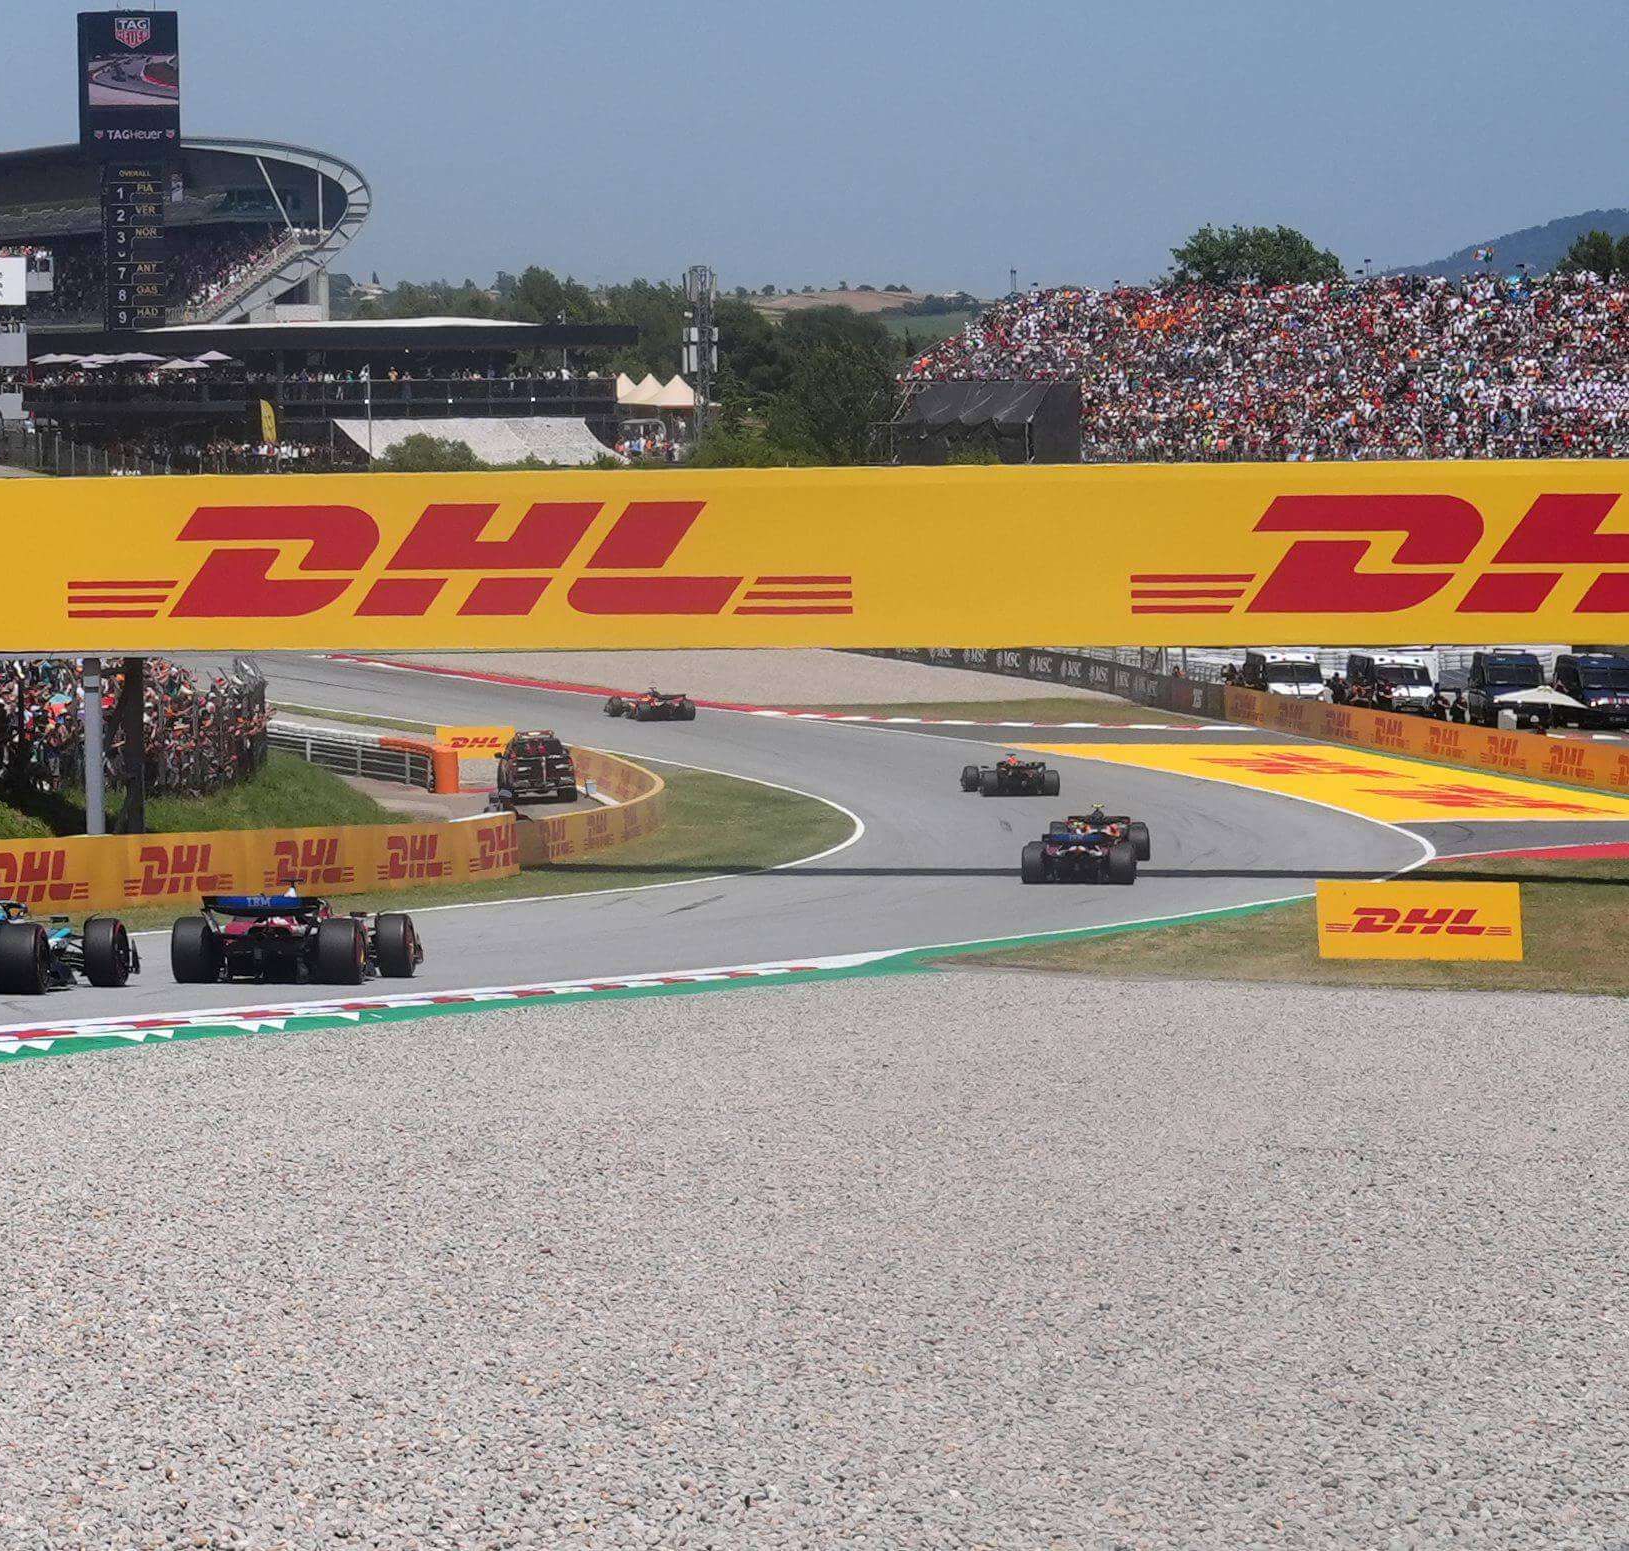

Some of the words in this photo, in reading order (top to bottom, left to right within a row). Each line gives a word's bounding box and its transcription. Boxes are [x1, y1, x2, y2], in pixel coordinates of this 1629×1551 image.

[119, 19, 147, 29] TAG
[117, 187, 124, 199] 1
[117, 209, 125, 222] 2
[135, 205, 156, 214] VER
[117, 231, 126, 244] 3
[118, 267, 126, 280] 7
[136, 264, 157, 272] ANT
[118, 289, 127, 302] 8
[119, 311, 127, 324] 9
[168, 501, 744, 617] DHL
[1244, 493, 1629, 613] DH
[450, 736, 502, 748] DHL
[275, 838, 343, 888] DHL
[384, 834, 443, 879] DHL
[140, 844, 220, 895] DHL
[246, 897, 271, 906] IBM
[1351, 907, 1486, 936] DHL
